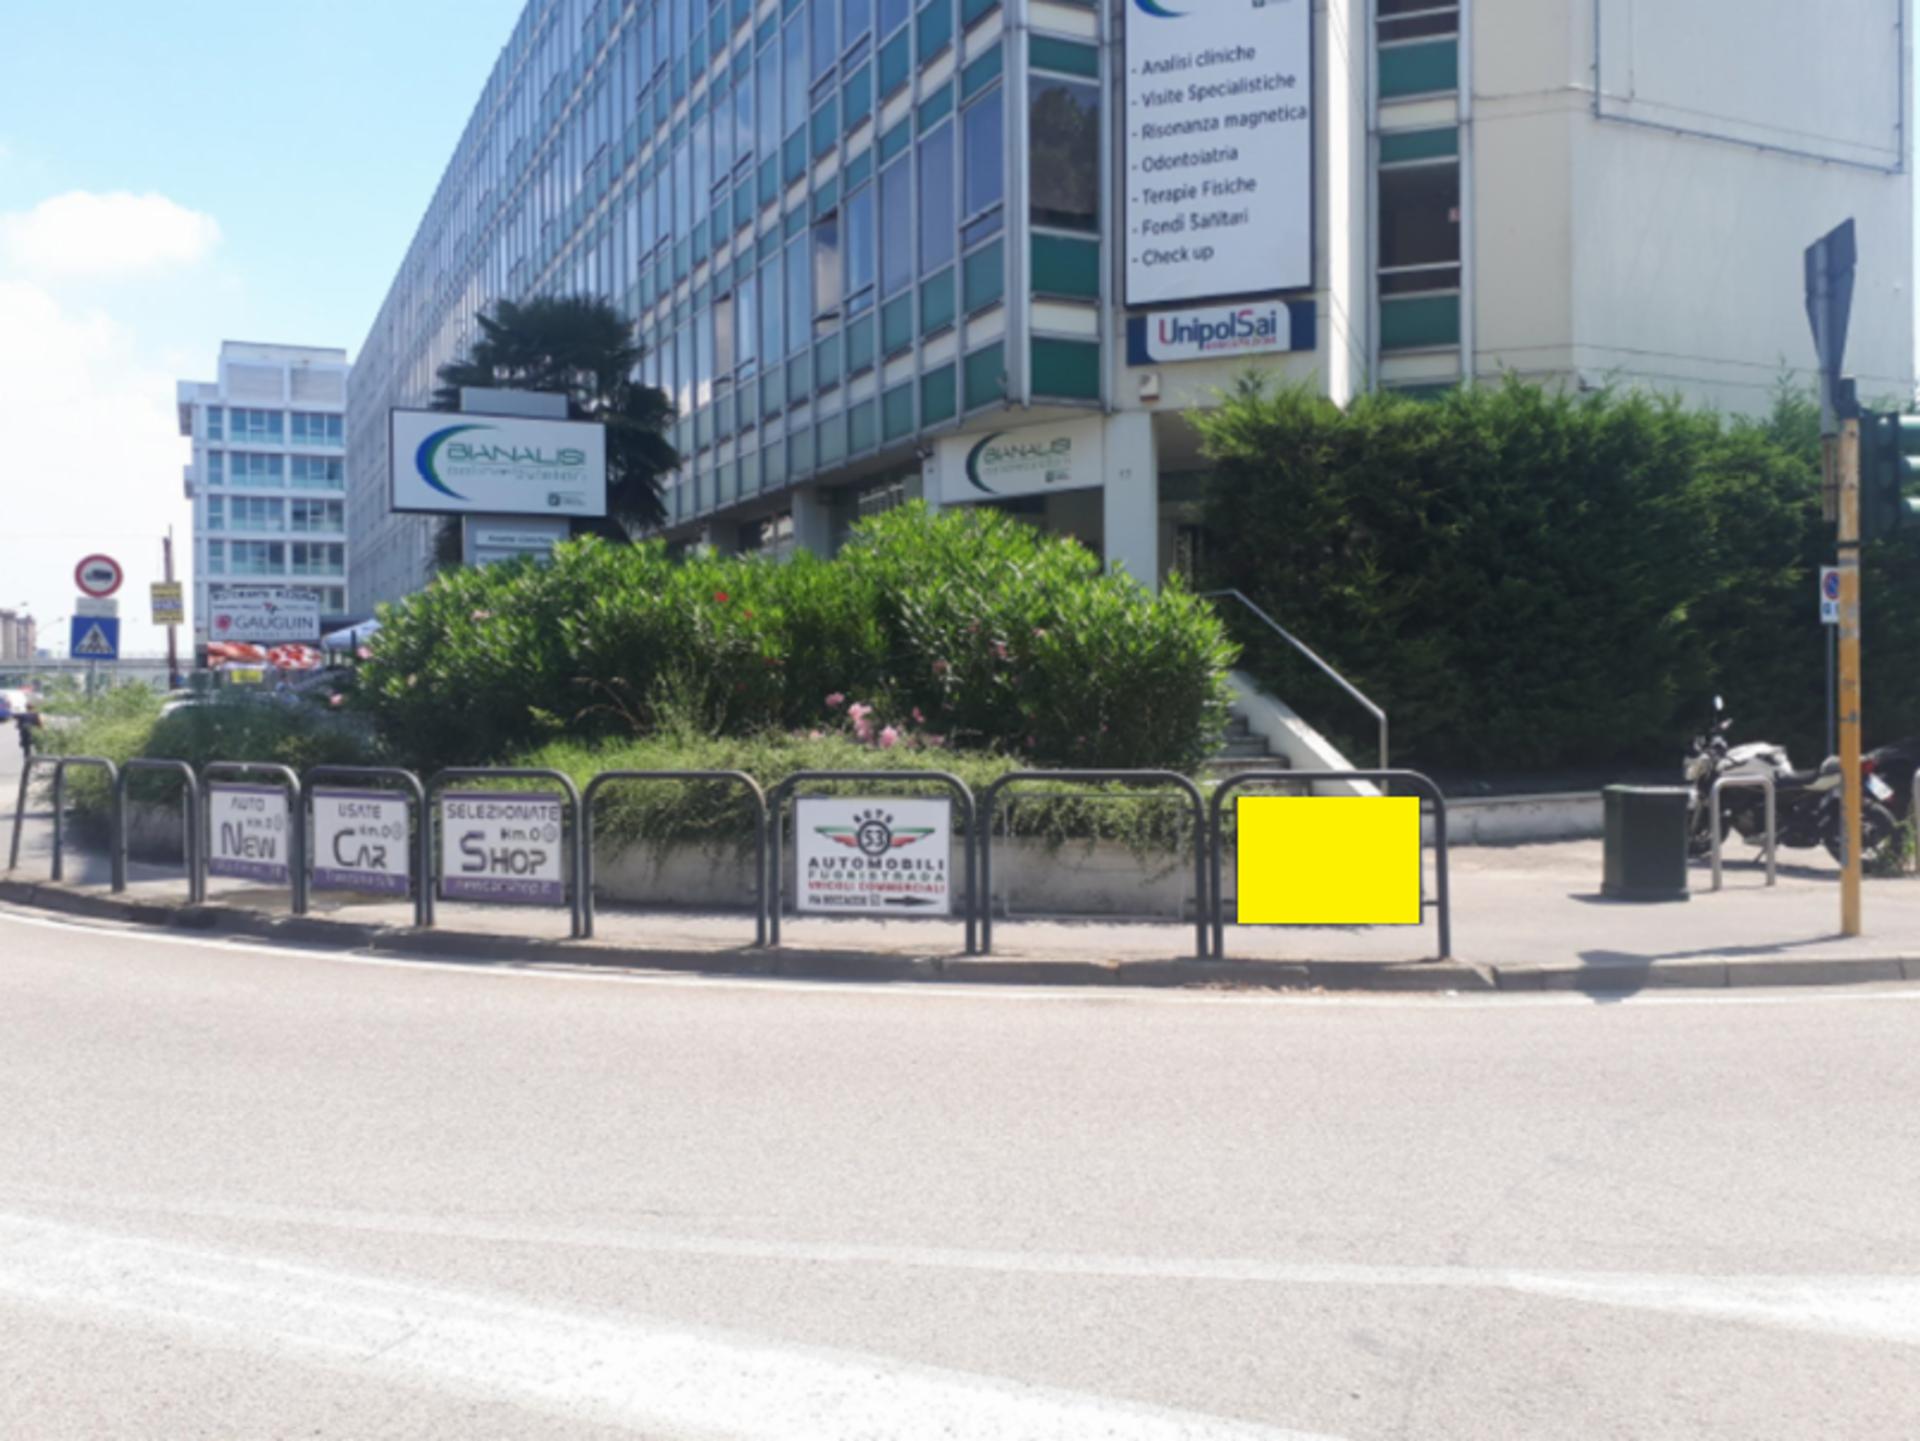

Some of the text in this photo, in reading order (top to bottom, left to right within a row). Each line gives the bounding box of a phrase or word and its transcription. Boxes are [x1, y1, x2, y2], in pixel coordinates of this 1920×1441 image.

[1142, 46, 1255, 75] Analisi cliniche
[1142, 73, 1296, 107] Visite Specialistiche
[1142, 104, 1307, 140] Risonanza magnetica
[1142, 147, 1239, 173] Odontoiatria
[1142, 176, 1257, 205] Terapie Fisiche
[1142, 208, 1249, 236] Fondi Sanitari
[1142, 246, 1214, 266] Check up
[1159, 309, 1277, 350] UnipolSai
[235, 615, 313, 630] GAUGUIN
[338, 803, 382, 819] USATE
[447, 803, 559, 821] SELEZIONATE
[460, 831, 547, 875] SHOP
[808, 858, 944, 871] AUTOMOBILI
[808, 871, 944, 881] FUORISTRADA
